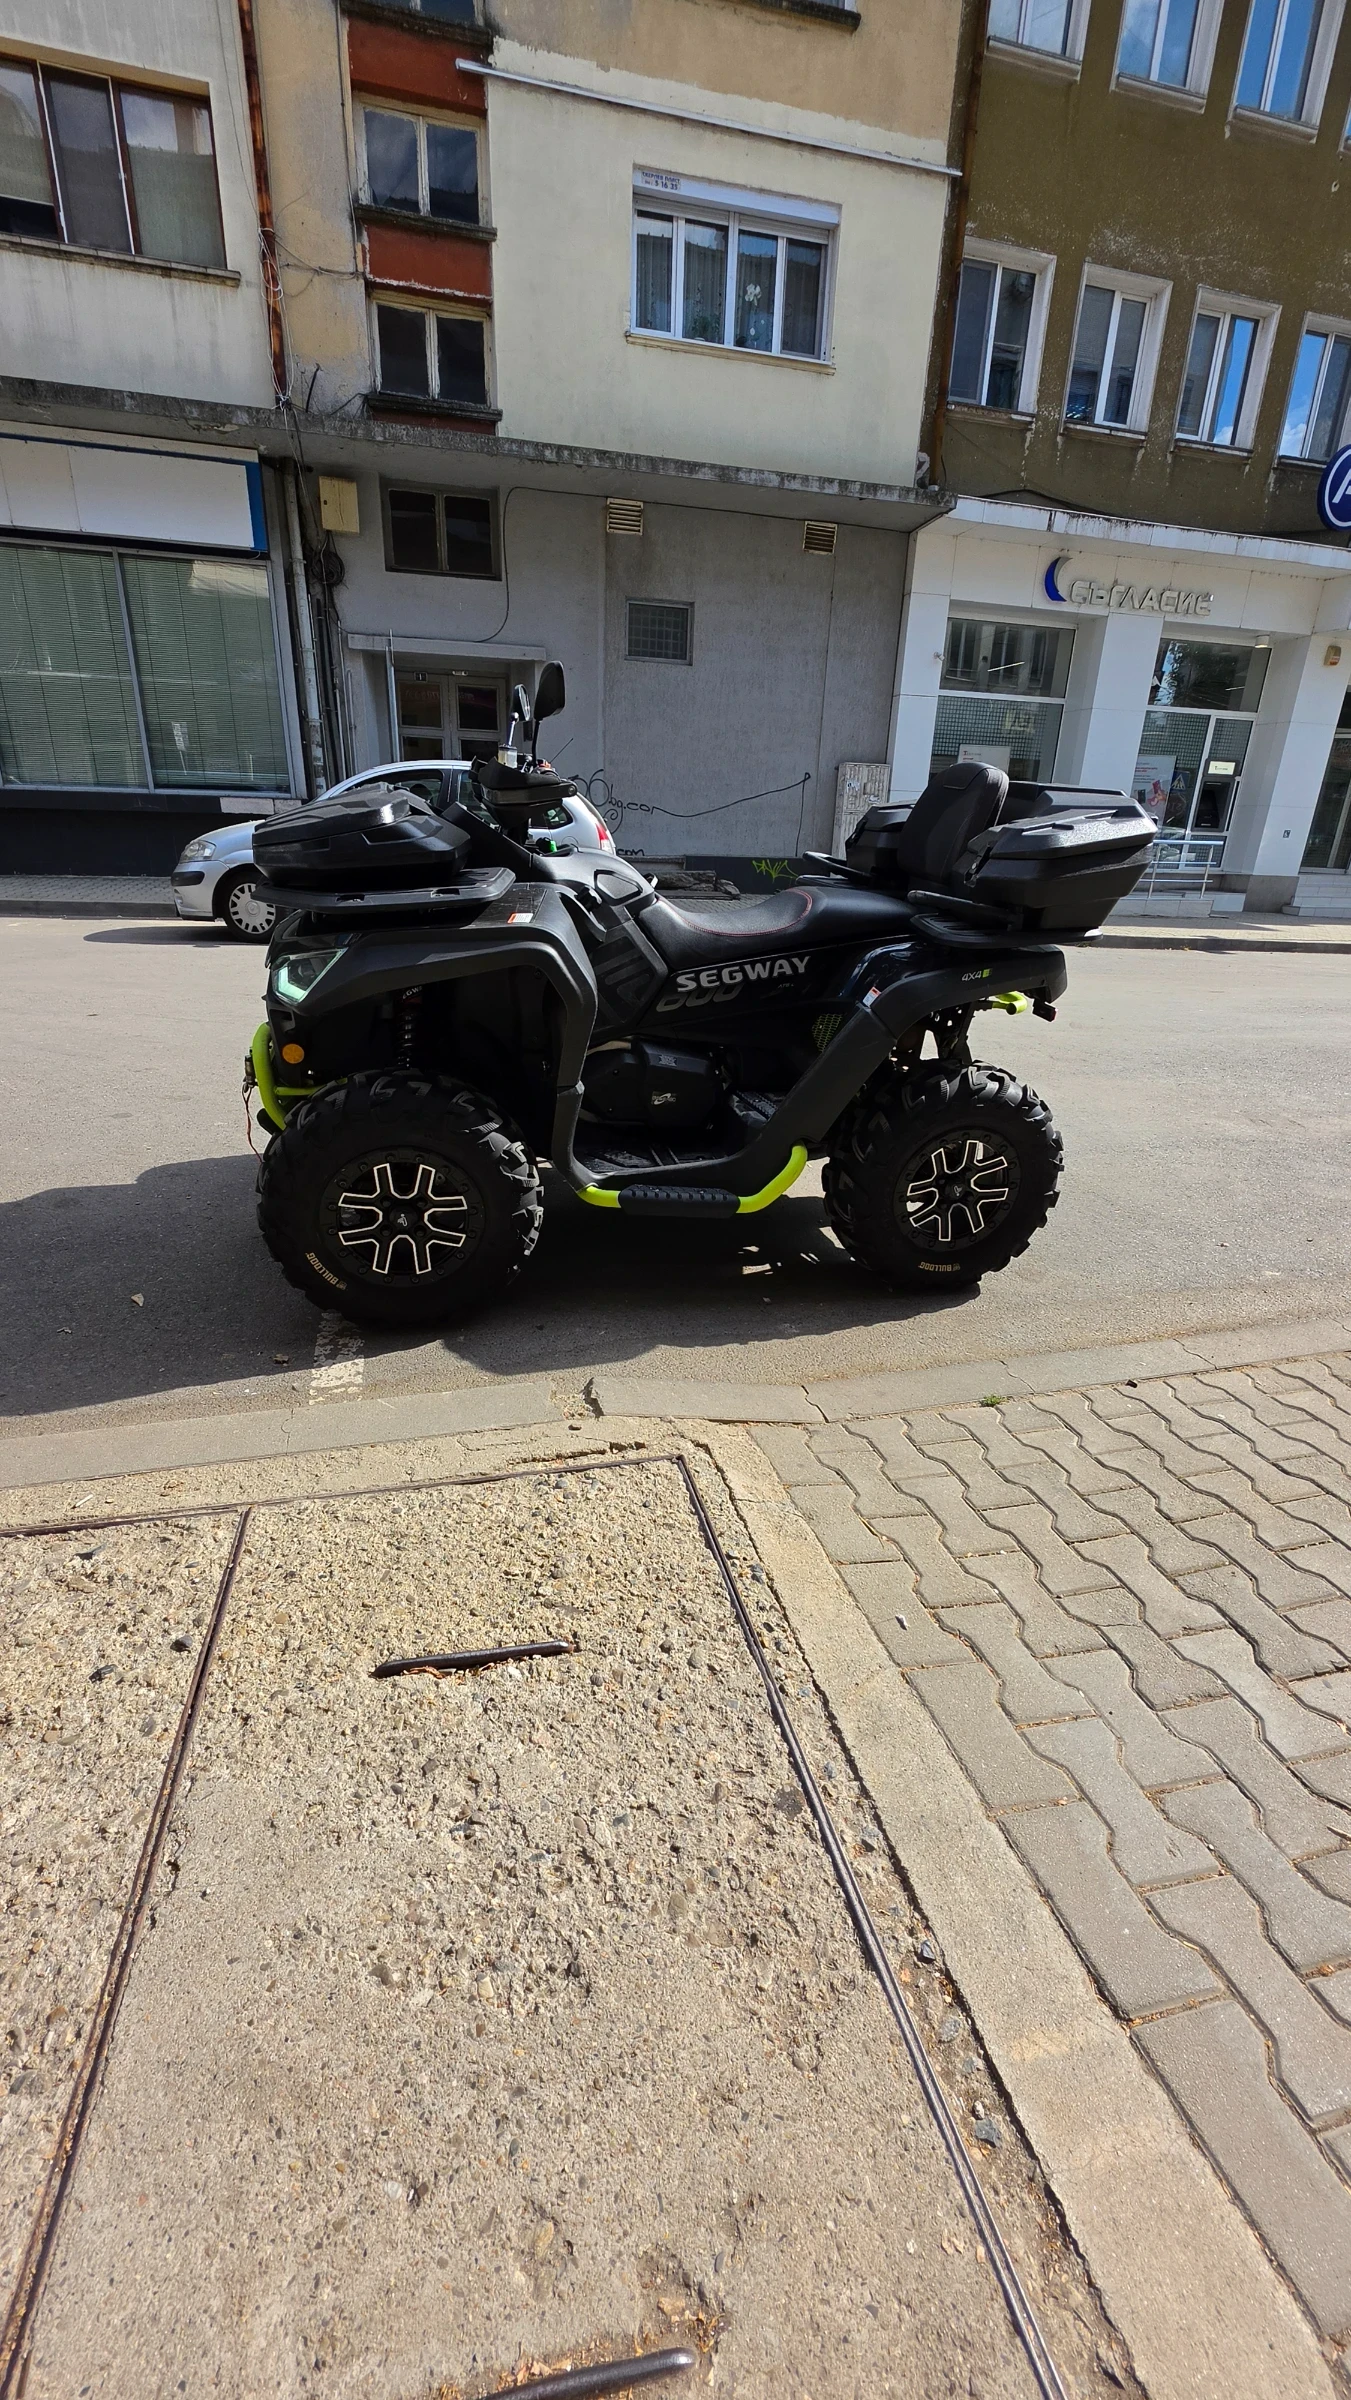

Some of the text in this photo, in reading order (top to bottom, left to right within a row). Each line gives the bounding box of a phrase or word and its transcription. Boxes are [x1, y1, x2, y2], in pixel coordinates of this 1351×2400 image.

[676, 955, 811, 993] SEGWAY
[962, 970, 982, 981] 4X4
[306, 1252, 339, 1285] BULLDOG
[920, 1261, 952, 1271] BULLDOG
